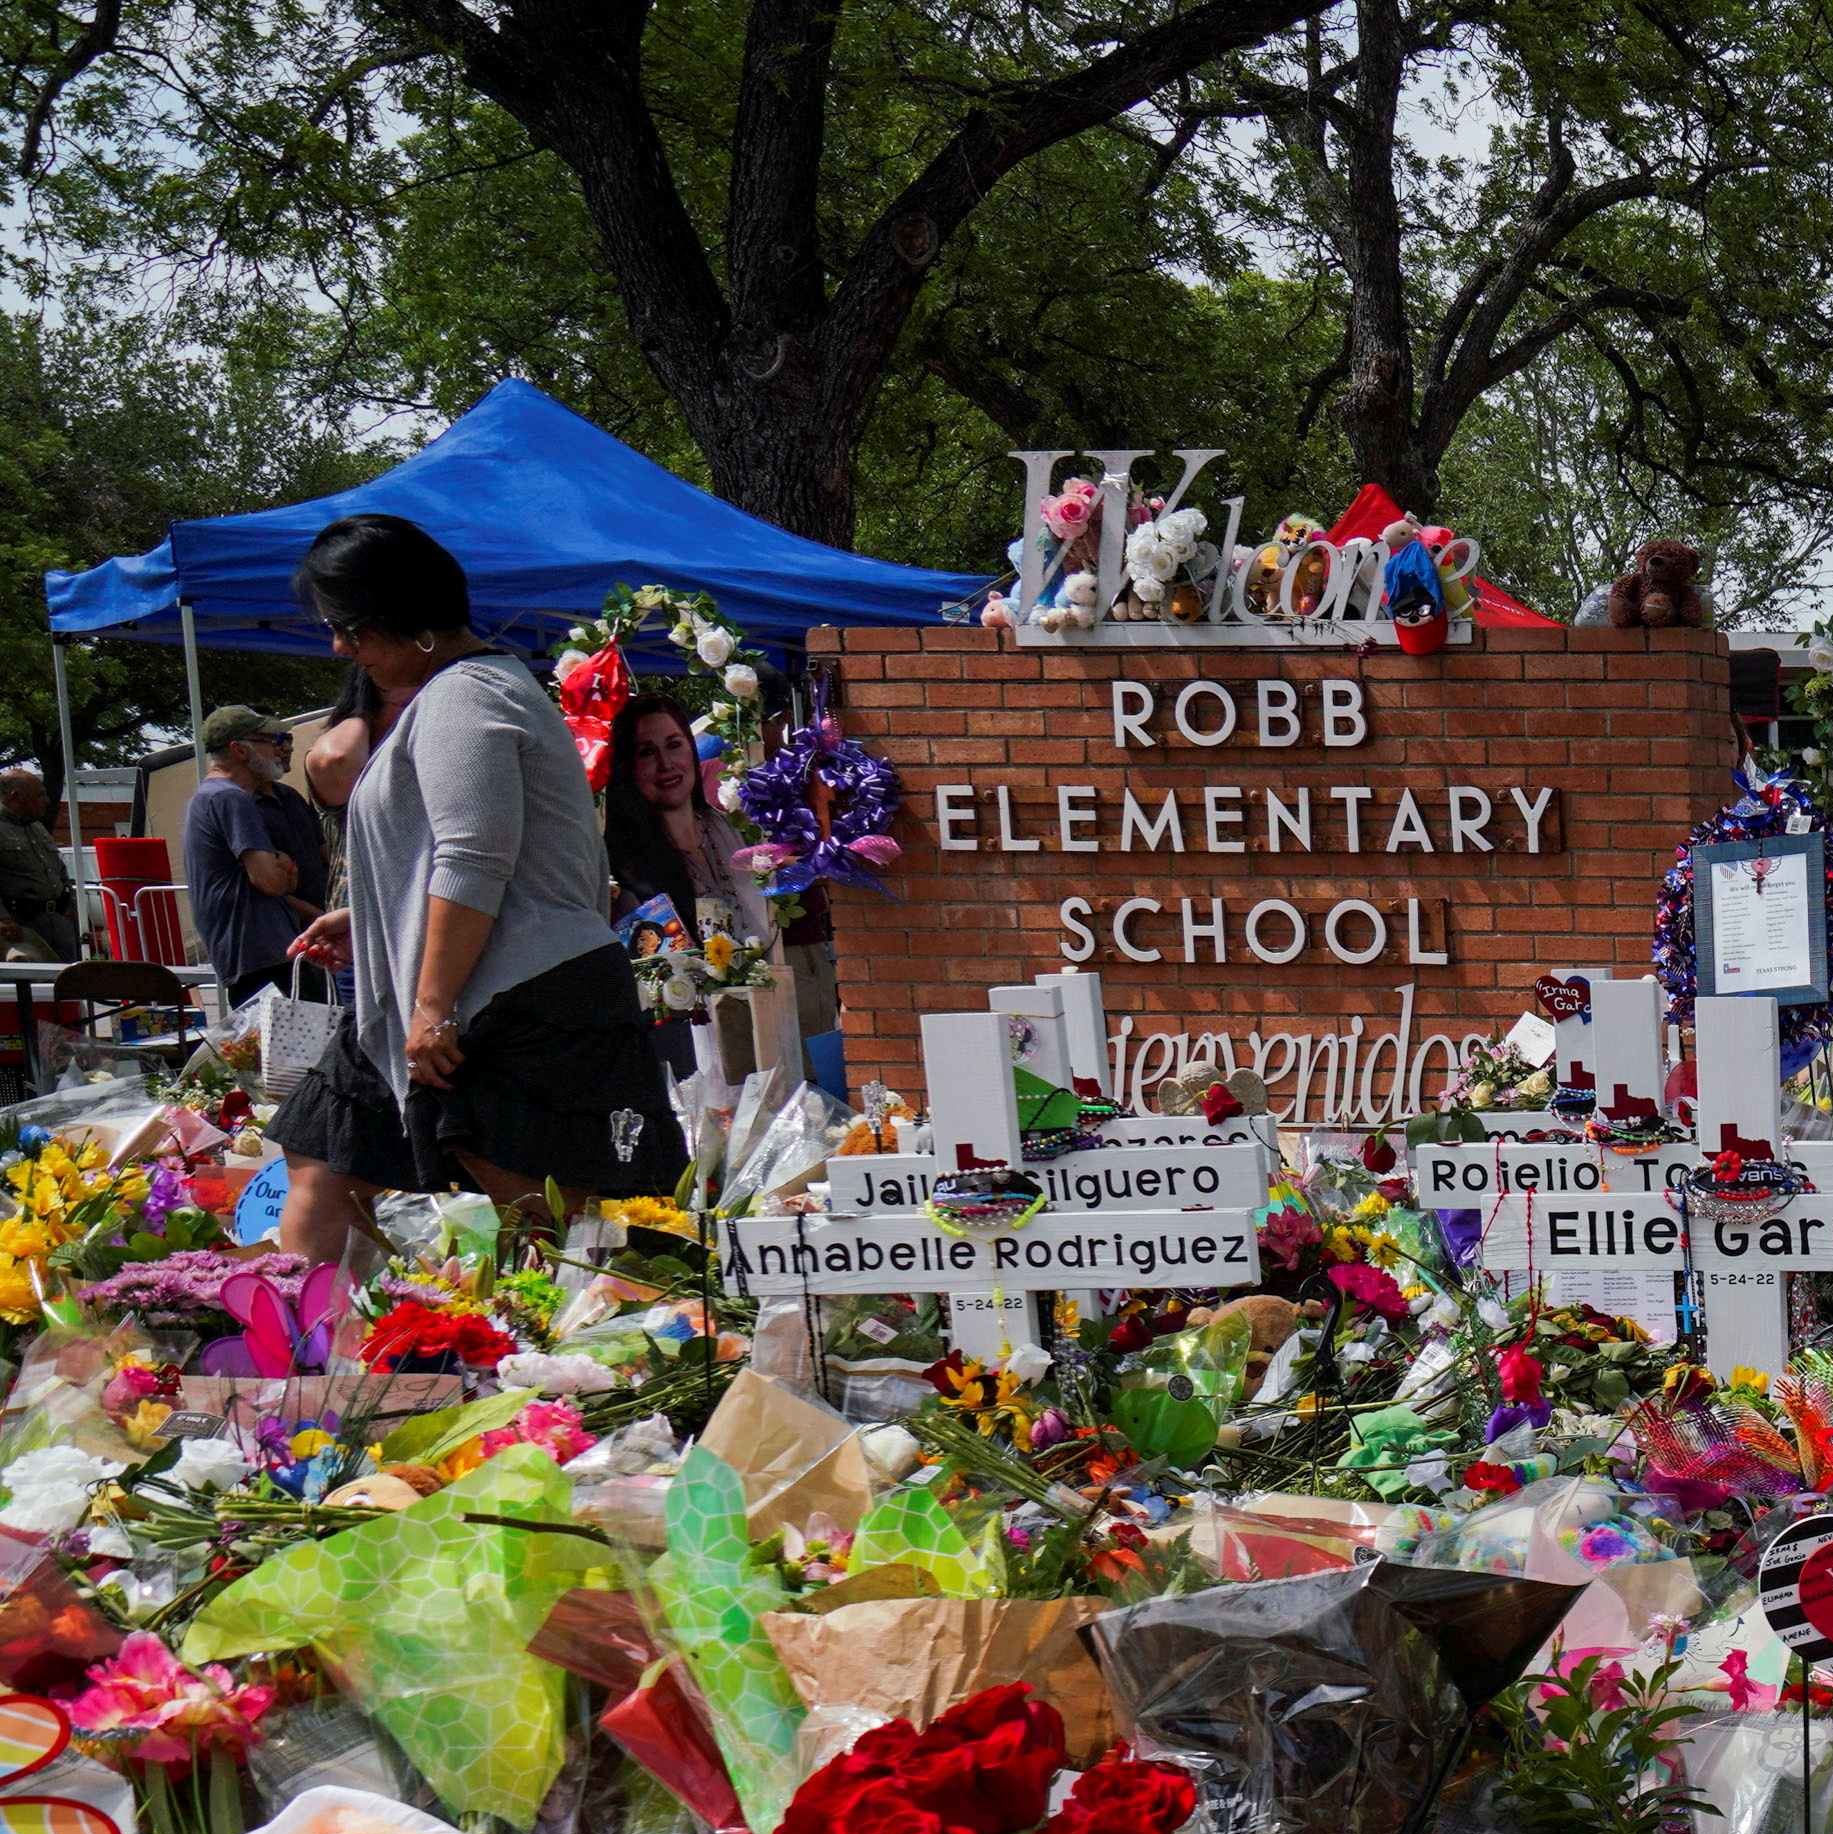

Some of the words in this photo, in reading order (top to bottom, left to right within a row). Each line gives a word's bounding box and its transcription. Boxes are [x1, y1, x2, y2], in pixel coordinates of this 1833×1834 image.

[1112, 680, 1368, 748] ROBB
[935, 785, 1554, 853] ELEMENTARY
[1059, 896, 1448, 966] SCHOOL
[1756, 967, 1773, 975] TEXAS
[1774, 964, 1798, 973] STRONG
[255, 1182, 287, 1201] Our
[1549, 1210, 1678, 1255] Ellie
[725, 1235, 976, 1276] Annabelle
[995, 1233, 1249, 1275] Rodriguez
[1710, 1273, 1775, 1285] 5-24-22
[956, 1297, 1024, 1311] 5-2422
